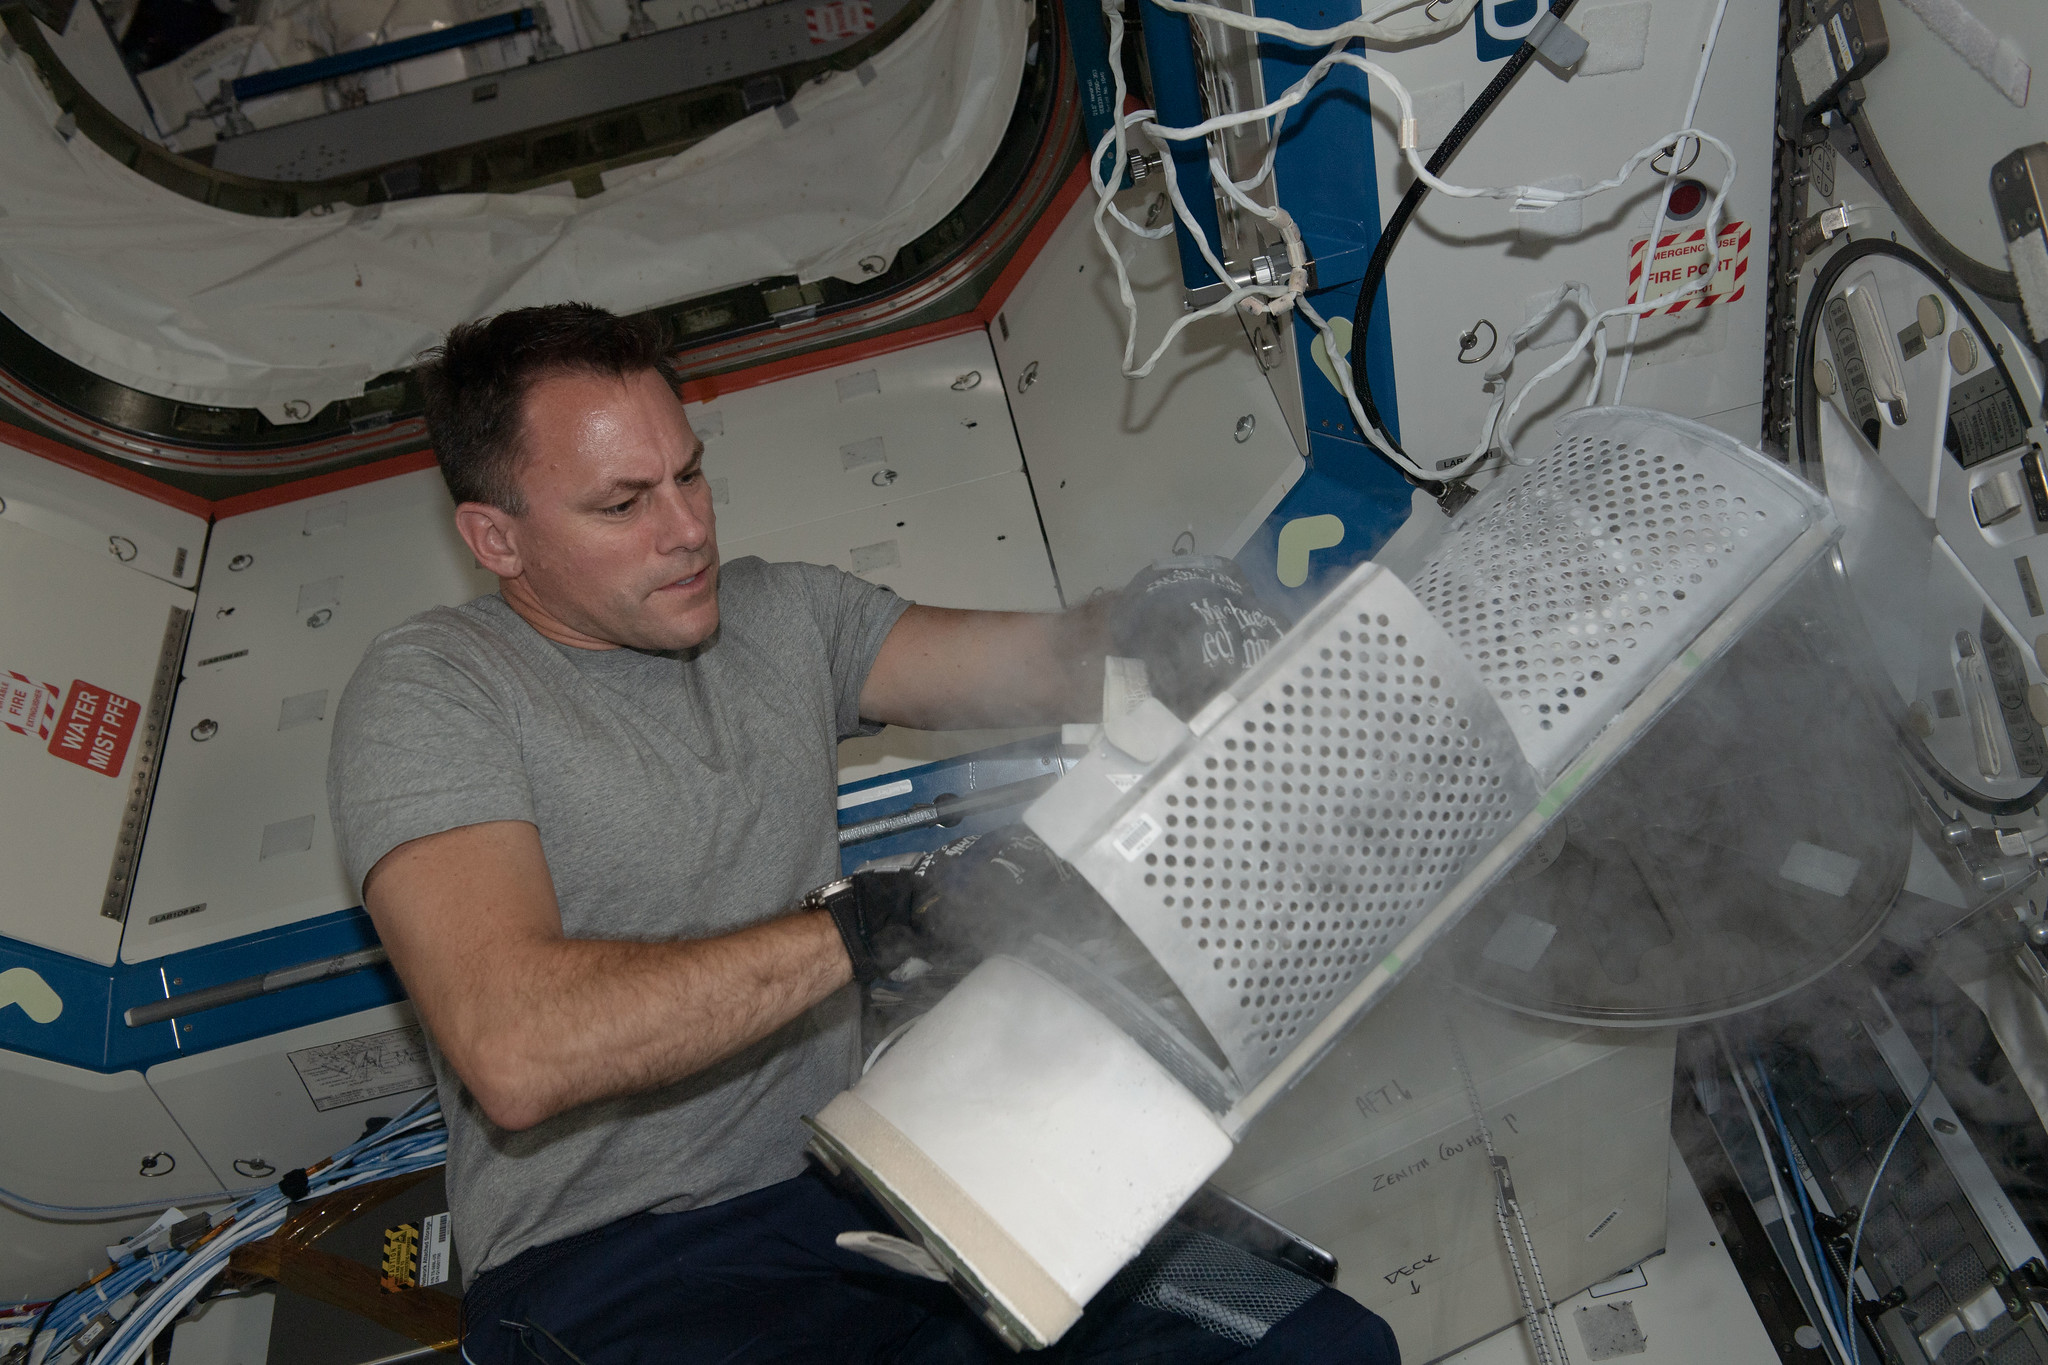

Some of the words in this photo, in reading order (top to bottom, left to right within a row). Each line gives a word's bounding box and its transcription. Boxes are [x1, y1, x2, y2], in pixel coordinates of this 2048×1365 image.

[1653, 243, 1707, 261] MERGENC
[1648, 268, 1682, 284] FIRE
[9, 689, 27, 715] FIRE
[26, 689, 42, 727] EXTINGUISHER
[102, 694, 129, 727] PFE
[61, 690, 100, 750] WATER
[87, 726, 118, 770] MIST
[1356, 1085, 1392, 1118] AFT
[1373, 1158, 1430, 1192] ZENITH
[424, 1222, 432, 1240] Storage
[1384, 1254, 1440, 1284] DECK
